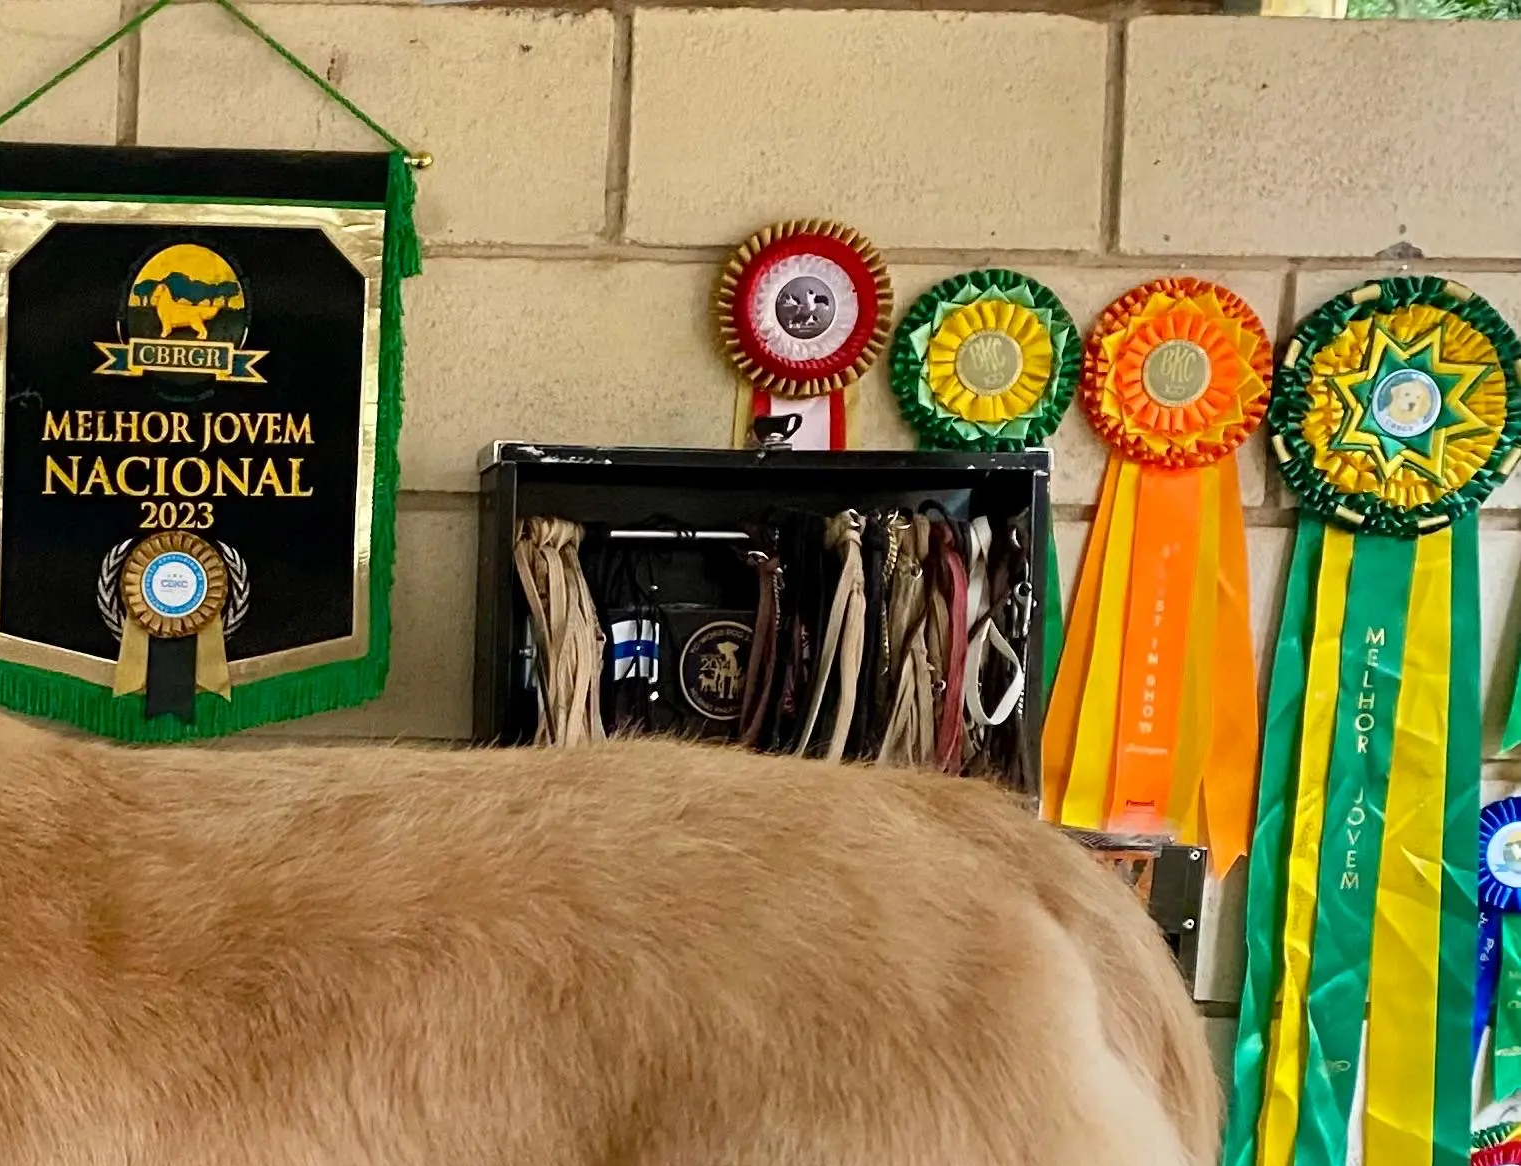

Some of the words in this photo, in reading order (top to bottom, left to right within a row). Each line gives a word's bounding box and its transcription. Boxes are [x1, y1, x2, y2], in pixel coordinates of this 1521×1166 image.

[139, 345, 223, 368] CBRGR
[41, 410, 195, 444] MELHOR
[199, 412, 315, 453] JOVEM
[41, 455, 314, 497] NACIONAL
[139, 501, 215, 529] 2023
[1354, 626, 1385, 754] MELHOR
[1340, 787, 1366, 890] JOVEM
